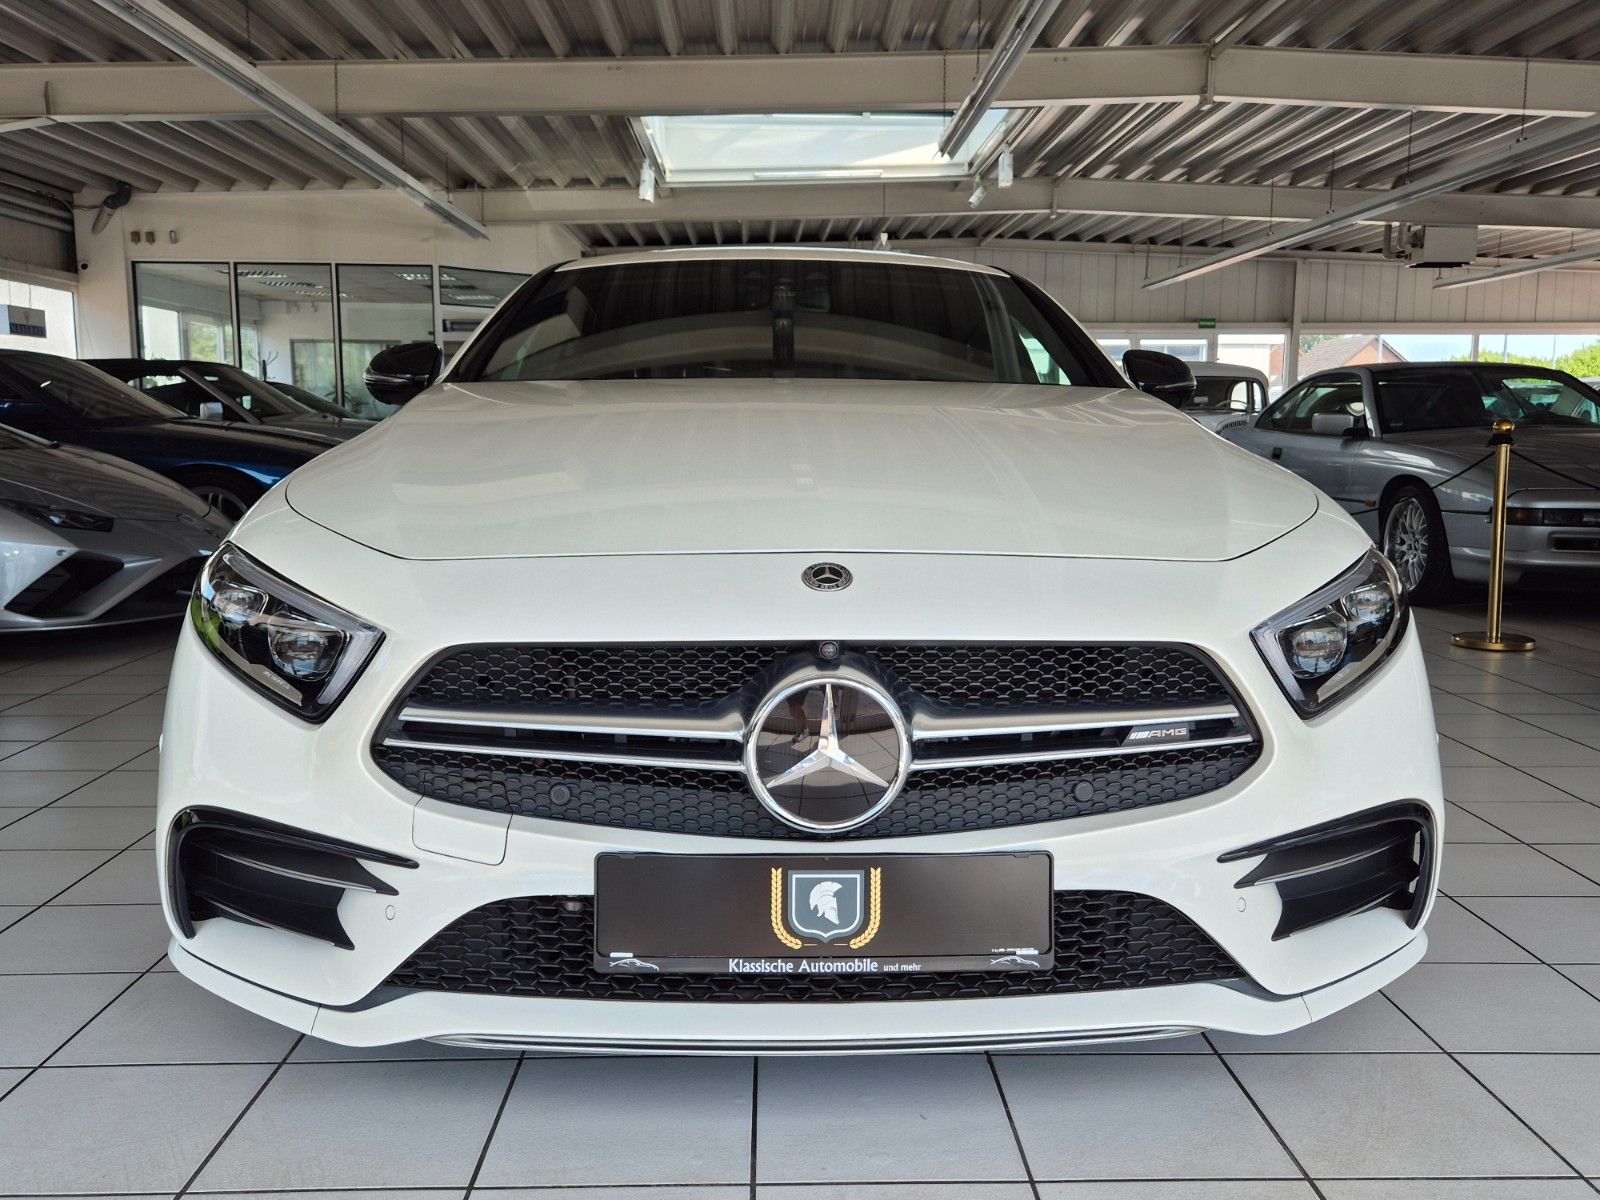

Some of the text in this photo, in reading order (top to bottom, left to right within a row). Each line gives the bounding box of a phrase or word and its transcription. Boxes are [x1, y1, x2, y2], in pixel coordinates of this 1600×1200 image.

[1146, 727, 1187, 739] AMG
[728, 958, 922, 973] Klassische Automobile und mehr
